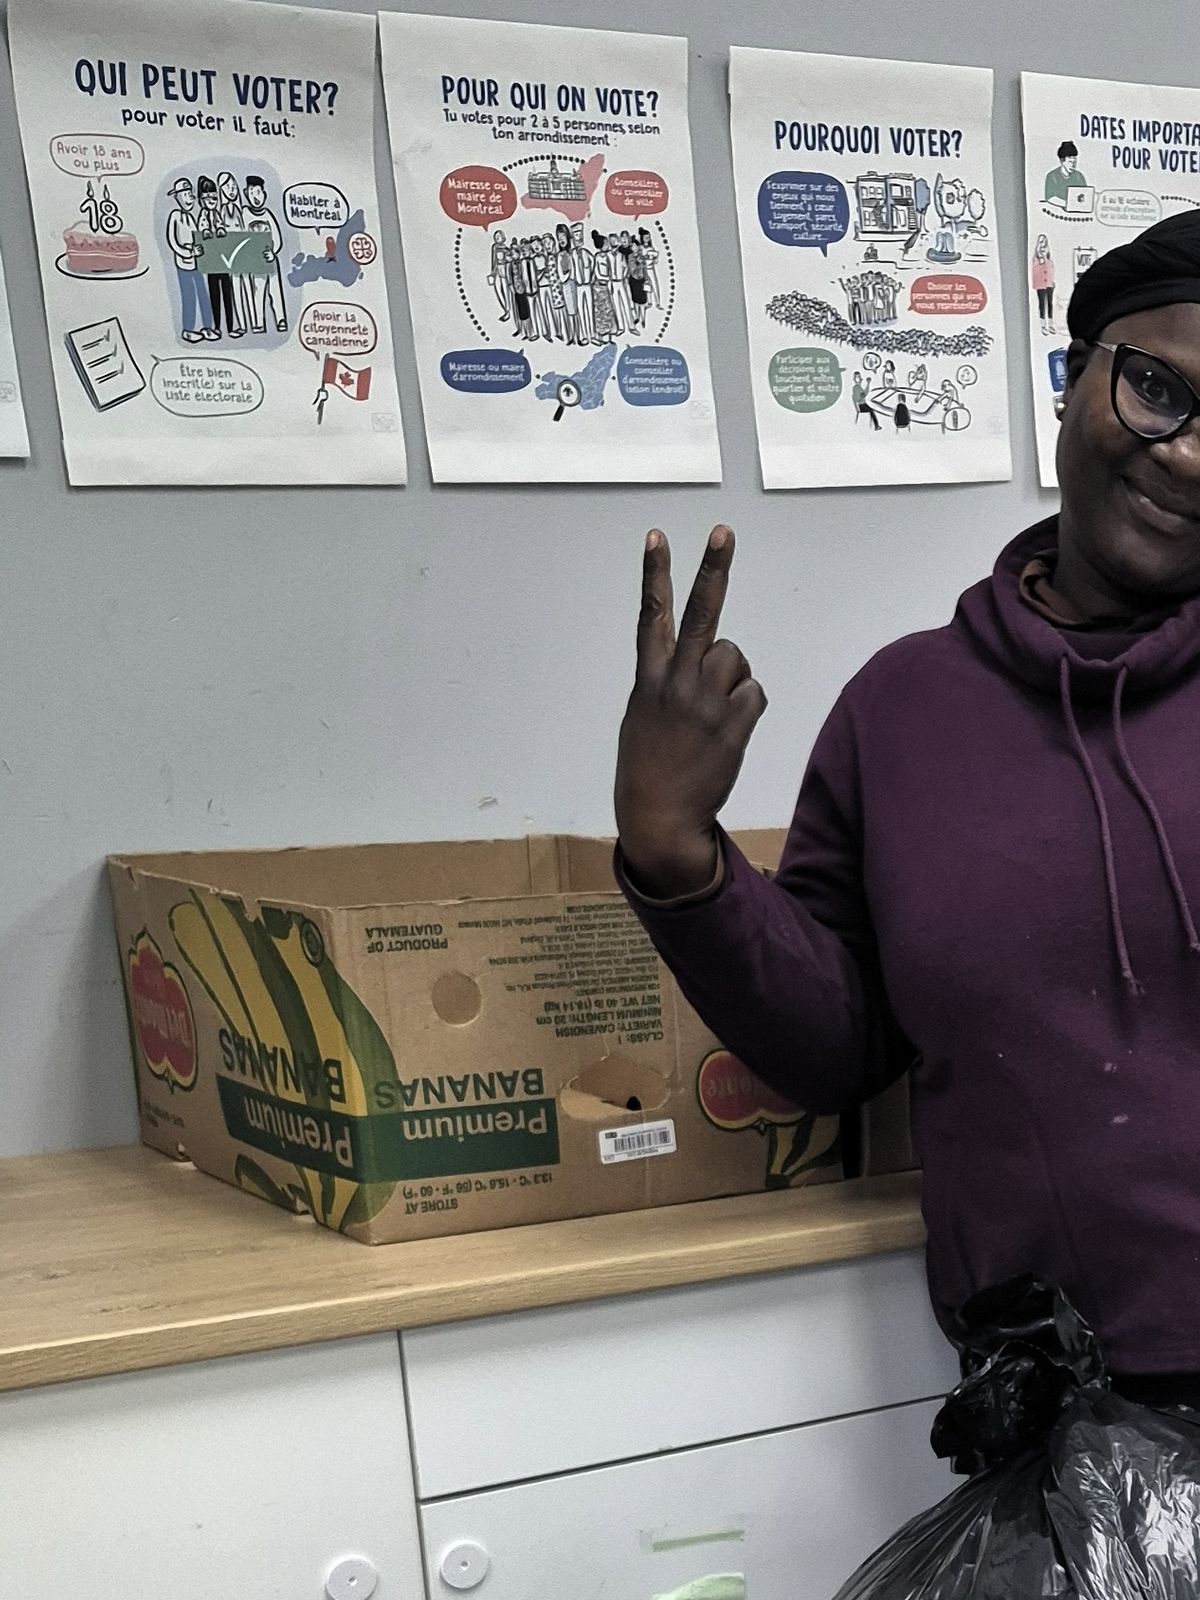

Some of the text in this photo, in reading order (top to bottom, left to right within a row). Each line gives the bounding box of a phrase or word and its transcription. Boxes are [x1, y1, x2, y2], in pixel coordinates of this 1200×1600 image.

[75, 59, 338, 116] QUI PEUT VOTER?
[441, 75, 659, 118] POUR QUI ON VOTE?
[122, 108, 295, 138] pour voter il faut:
[443, 108, 458, 122] Tu
[461, 111, 493, 125] votes
[497, 114, 525, 127] pour
[530, 114, 538, 128] 2
[542, 116, 549, 129] à
[553, 115, 560, 129] 5
[628, 122, 660, 135] selon
[1080, 113, 1126, 140] DATES
[492, 126, 610, 147] ton arrondissement
[775, 120, 962, 158] POURQUOI VOTER?
[57, 142, 132, 160] Avoir 18 ans
[1112, 145, 1151, 170] POUR
[74, 157, 120, 172] ou plus
[448, 178, 491, 191] Mairesse
[289, 193, 329, 207] Habiter
[489, 192, 502, 204] de
[80, 197, 123, 234] 18
[291, 207, 342, 221] Montréal
[313, 309, 341, 322] Avoir
[303, 323, 369, 337] citoyenneté
[305, 334, 369, 347] canadienne
[207, 367, 232, 378] bien
[365, 924, 443, 939] GUATEMALA
[367, 938, 448, 954] PRODUCT OF
[556, 1020, 663, 1037] VARIETY: CAVENDISH
[219, 1029, 347, 1104] BANANAS
[374, 1067, 544, 1109] BANANAS
[243, 1096, 353, 1168] Premium
[402, 1107, 548, 1142] Premium
[405, 1197, 458, 1214] STORE AT
